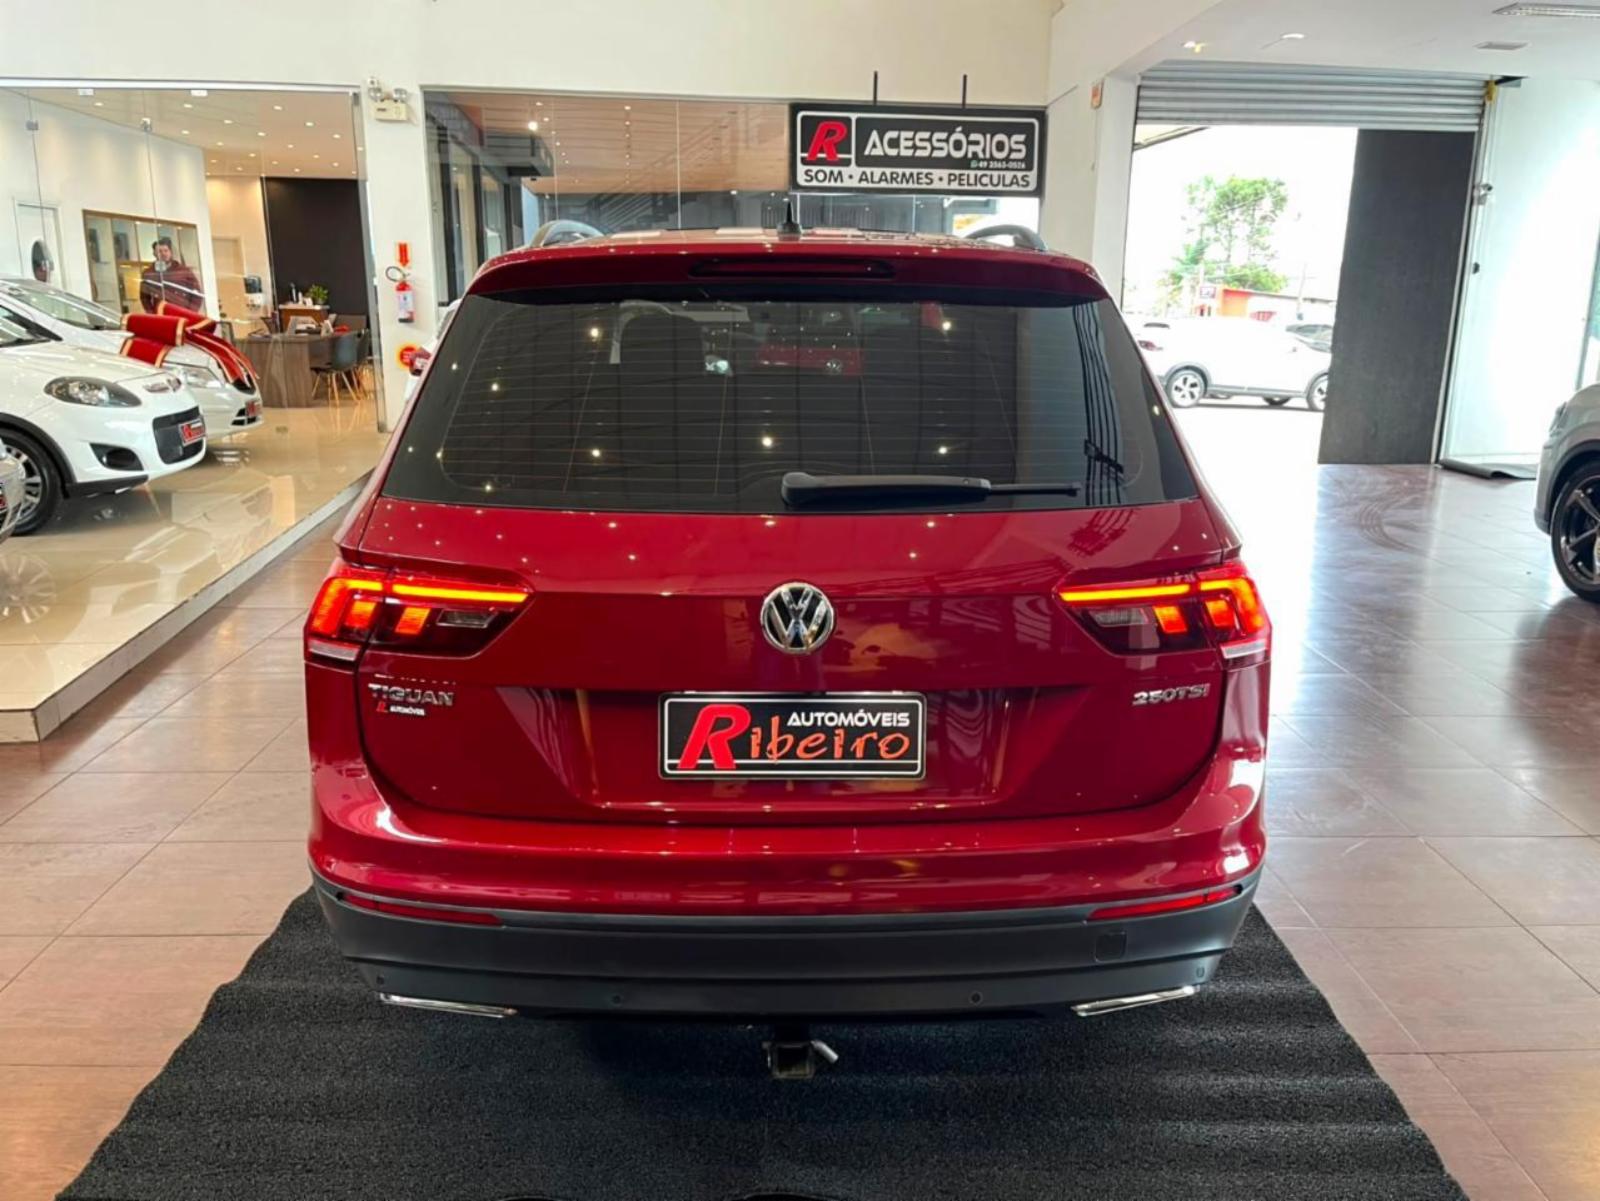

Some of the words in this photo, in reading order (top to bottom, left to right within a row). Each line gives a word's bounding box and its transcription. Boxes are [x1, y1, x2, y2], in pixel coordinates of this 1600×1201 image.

[864, 126, 1027, 160] ACESSÓRIOS
[803, 168, 845, 184] SOM
[858, 171, 934, 187] ALARMES
[947, 173, 1031, 189] PELICULAS
[368, 682, 454, 706] TIGUAN
[787, 709, 910, 728] AUTOMÓVEIS
